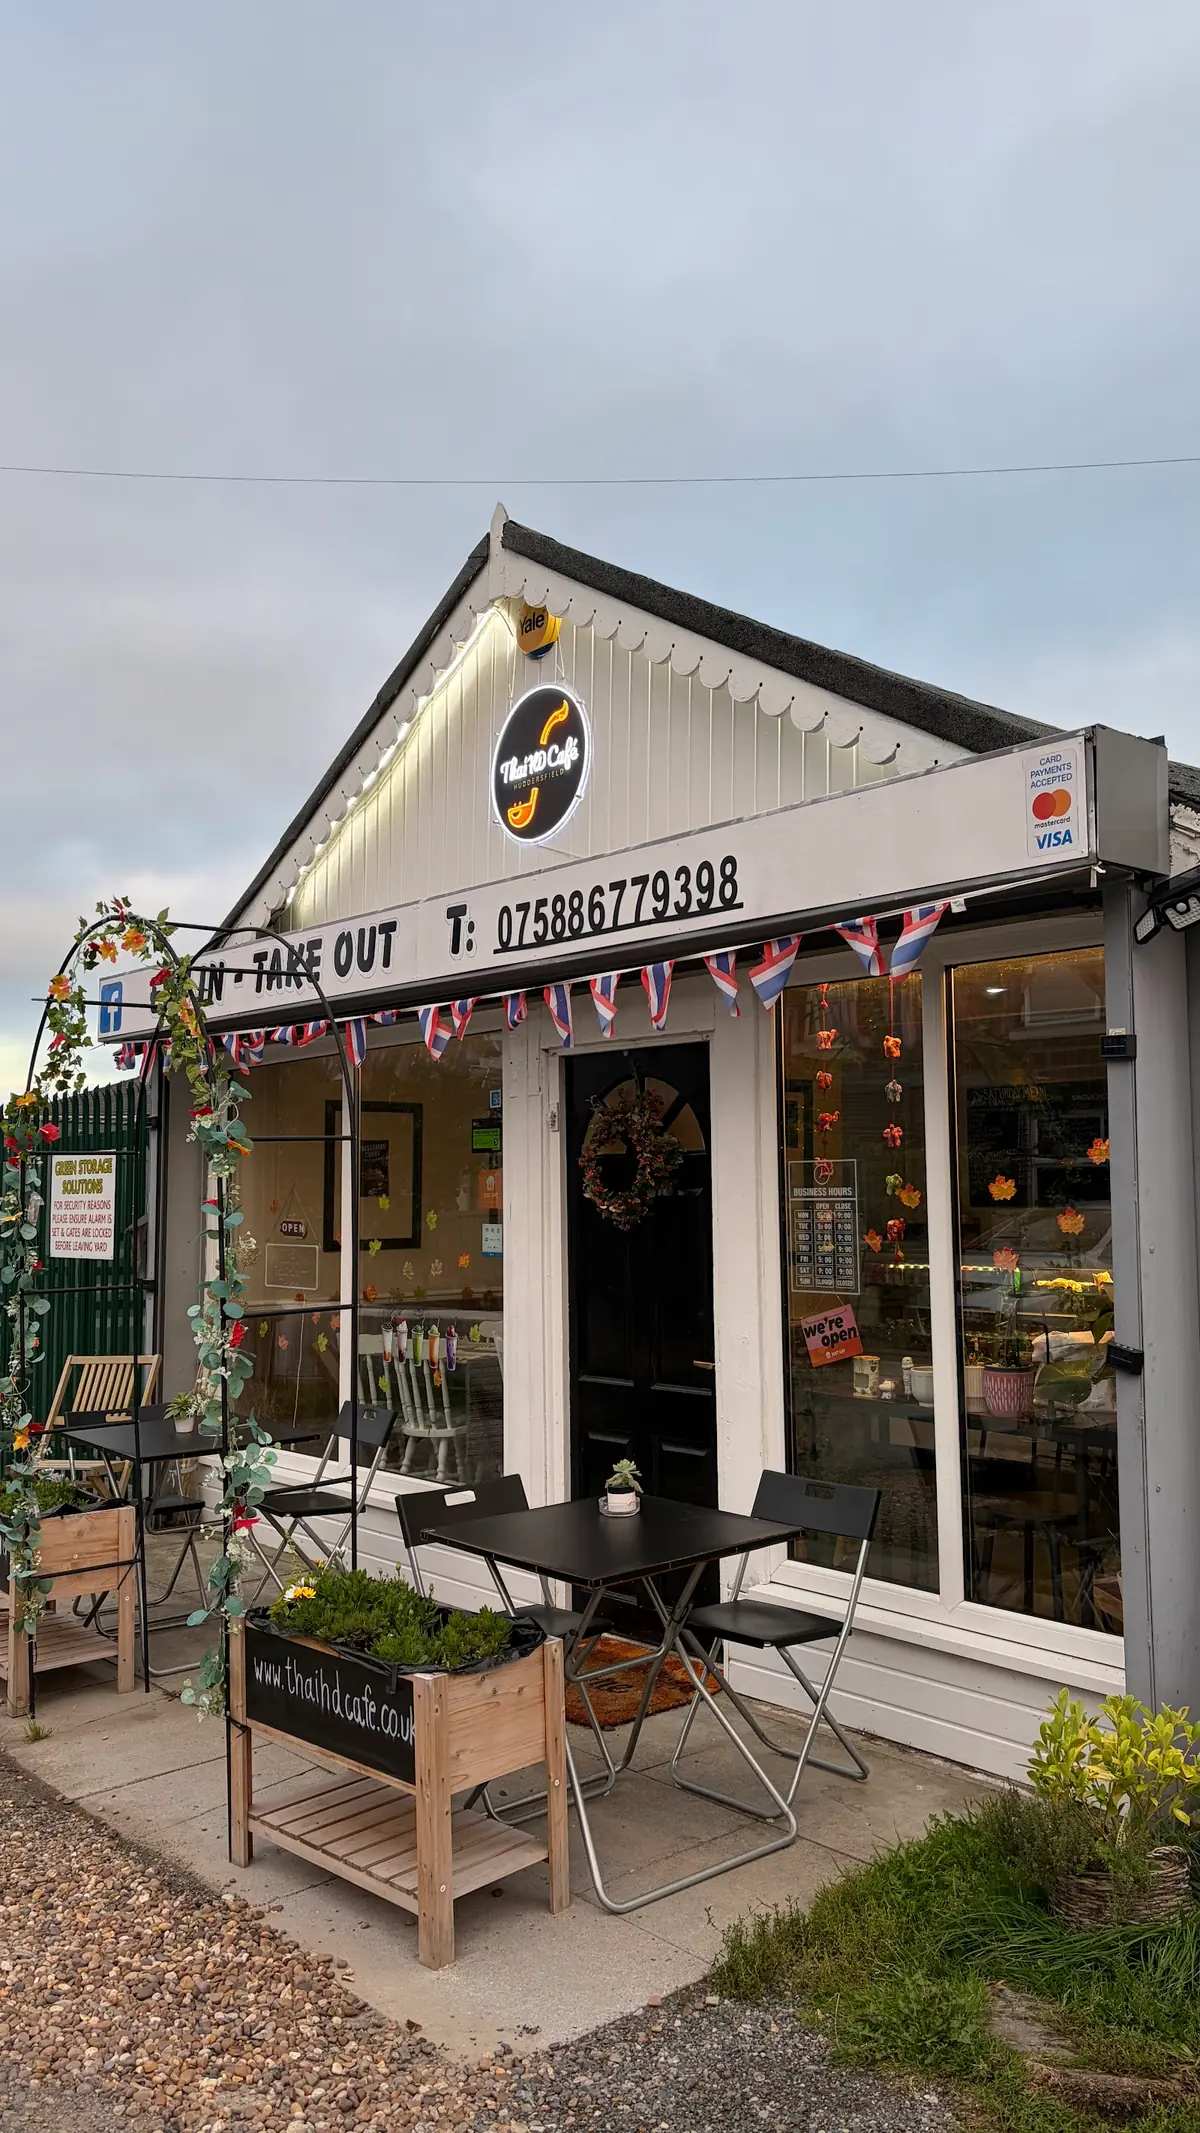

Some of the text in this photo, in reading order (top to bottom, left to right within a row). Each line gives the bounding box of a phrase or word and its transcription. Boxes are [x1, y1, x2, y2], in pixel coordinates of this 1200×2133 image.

[519, 612, 545, 636] Yale
[547, 735, 580, 771] Café
[1039, 753, 1062, 766] CARD
[1030, 762, 1072, 778] PAYMENTS
[513, 768, 564, 791] HUDDERSFIELD
[1030, 773, 1073, 789] ACCEPTED
[1034, 816, 1071, 829] mastercard
[1034, 829, 1073, 850] VISA
[253, 938, 322, 994] TAKE
[334, 920, 398, 977] OUT
[446, 903, 475, 955] T:
[497, 855, 739, 950] 075886779398
[55, 1158, 113, 1176] GREEN STORAGE
[62, 1178, 103, 1195] SOLUTIONS
[793, 1187, 852, 1196] BUSINESS HOURS
[54, 1200, 111, 1210] FOR SECURITY REASONS
[52, 1214, 112, 1224] PLEASE ENSURE ALARM IS
[52, 1228, 112, 1238] SET & GATES ARE LOCKED
[281, 1222, 305, 1233] OPEN
[55, 1241, 107, 1252] BEFORE LEAVING YARD
[821, 1326, 858, 1349] open
[253, 1656, 416, 1746] www.thaihdcafe.co.uk
